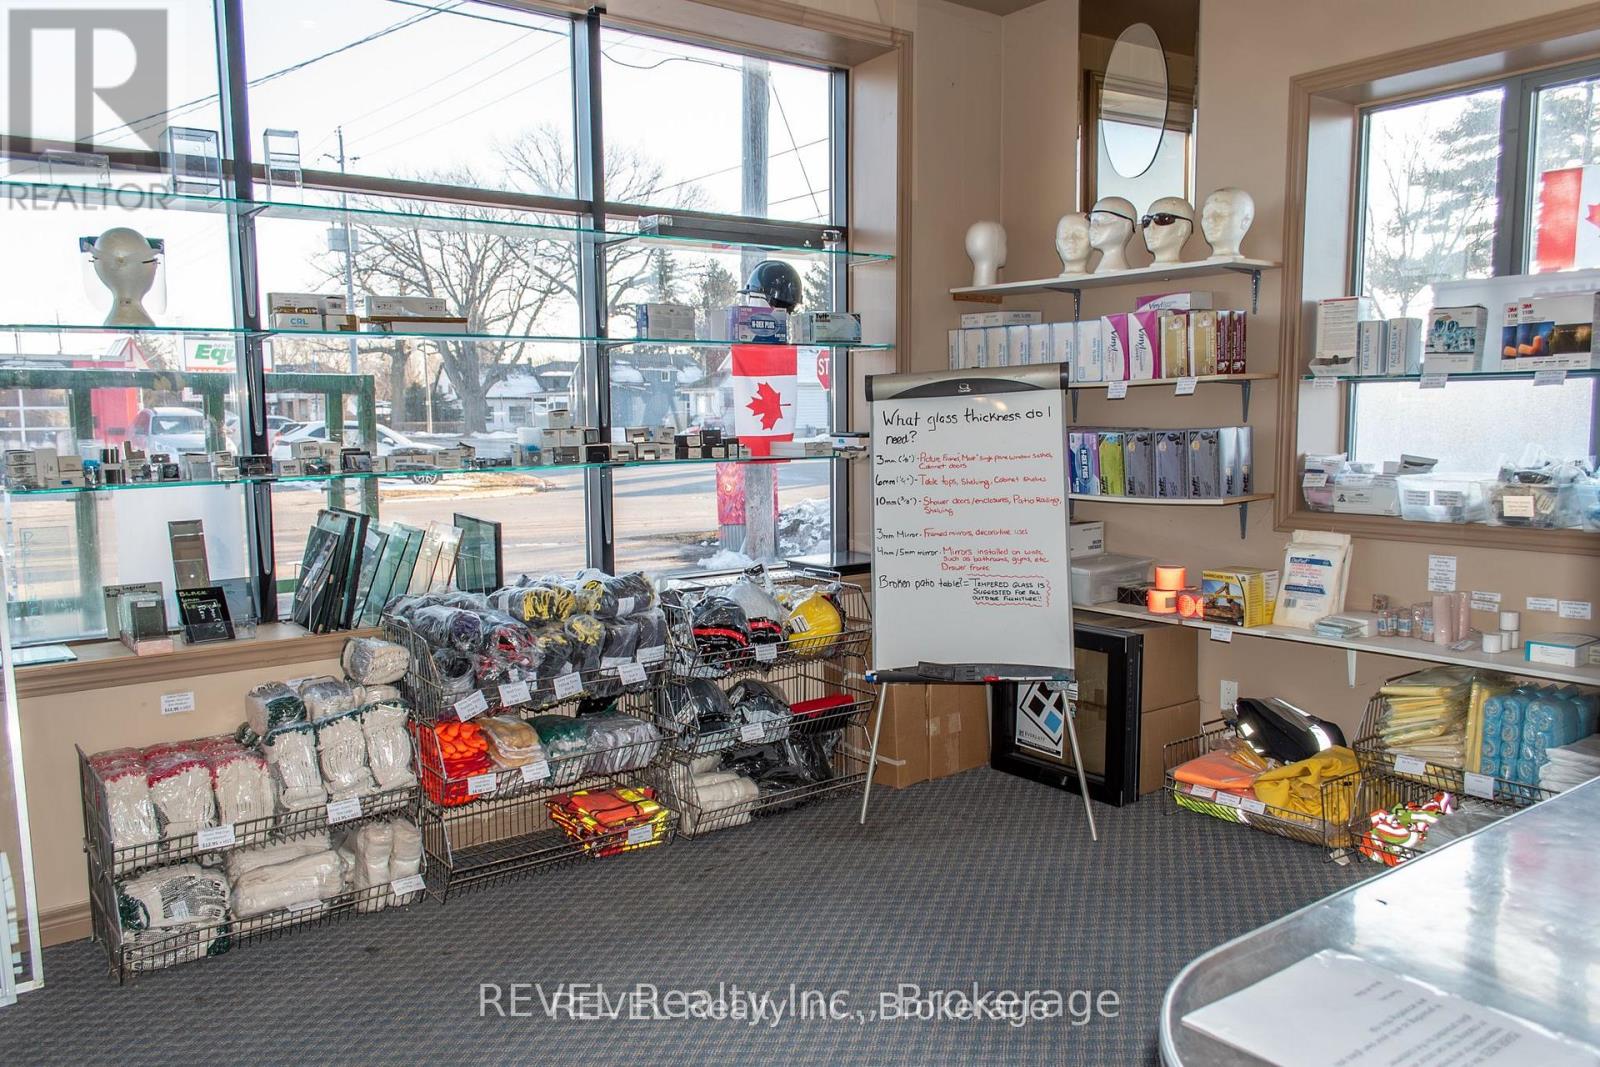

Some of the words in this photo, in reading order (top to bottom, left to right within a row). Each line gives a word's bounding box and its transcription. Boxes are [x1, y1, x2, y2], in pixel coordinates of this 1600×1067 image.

[290, 318, 308, 326] CRL
[1111, 330, 1119, 352] Vinyl
[1138, 327, 1146, 350] Vinyl
[883, 408, 920, 427] What
[927, 412, 958, 432] glass
[964, 408, 1021, 424] thickness
[1026, 408, 1043, 419] do
[1048, 405, 1051, 418] I
[886, 430, 917, 445] need?
[876, 455, 896, 465] 3mm
[920, 452, 941, 463] Picture
[919, 462, 946, 470] Cabinet
[876, 474, 895, 486] 6mm
[918, 474, 938, 485] Table
[994, 476, 1019, 484] Cabinet
[876, 496, 896, 506] 10mm
[924, 496, 949, 506] Shower
[1013, 494, 1034, 504] Patio
[924, 506, 954, 517] Shelving
[876, 528, 894, 540] 3mm
[897, 530, 918, 538] Mirror
[924, 528, 947, 538] Framed
[943, 546, 973, 556] Mirrors
[941, 562, 966, 571] Drawer
[879, 574, 911, 588] Broken
[915, 578, 935, 590] patio
[938, 577, 963, 587] table?
